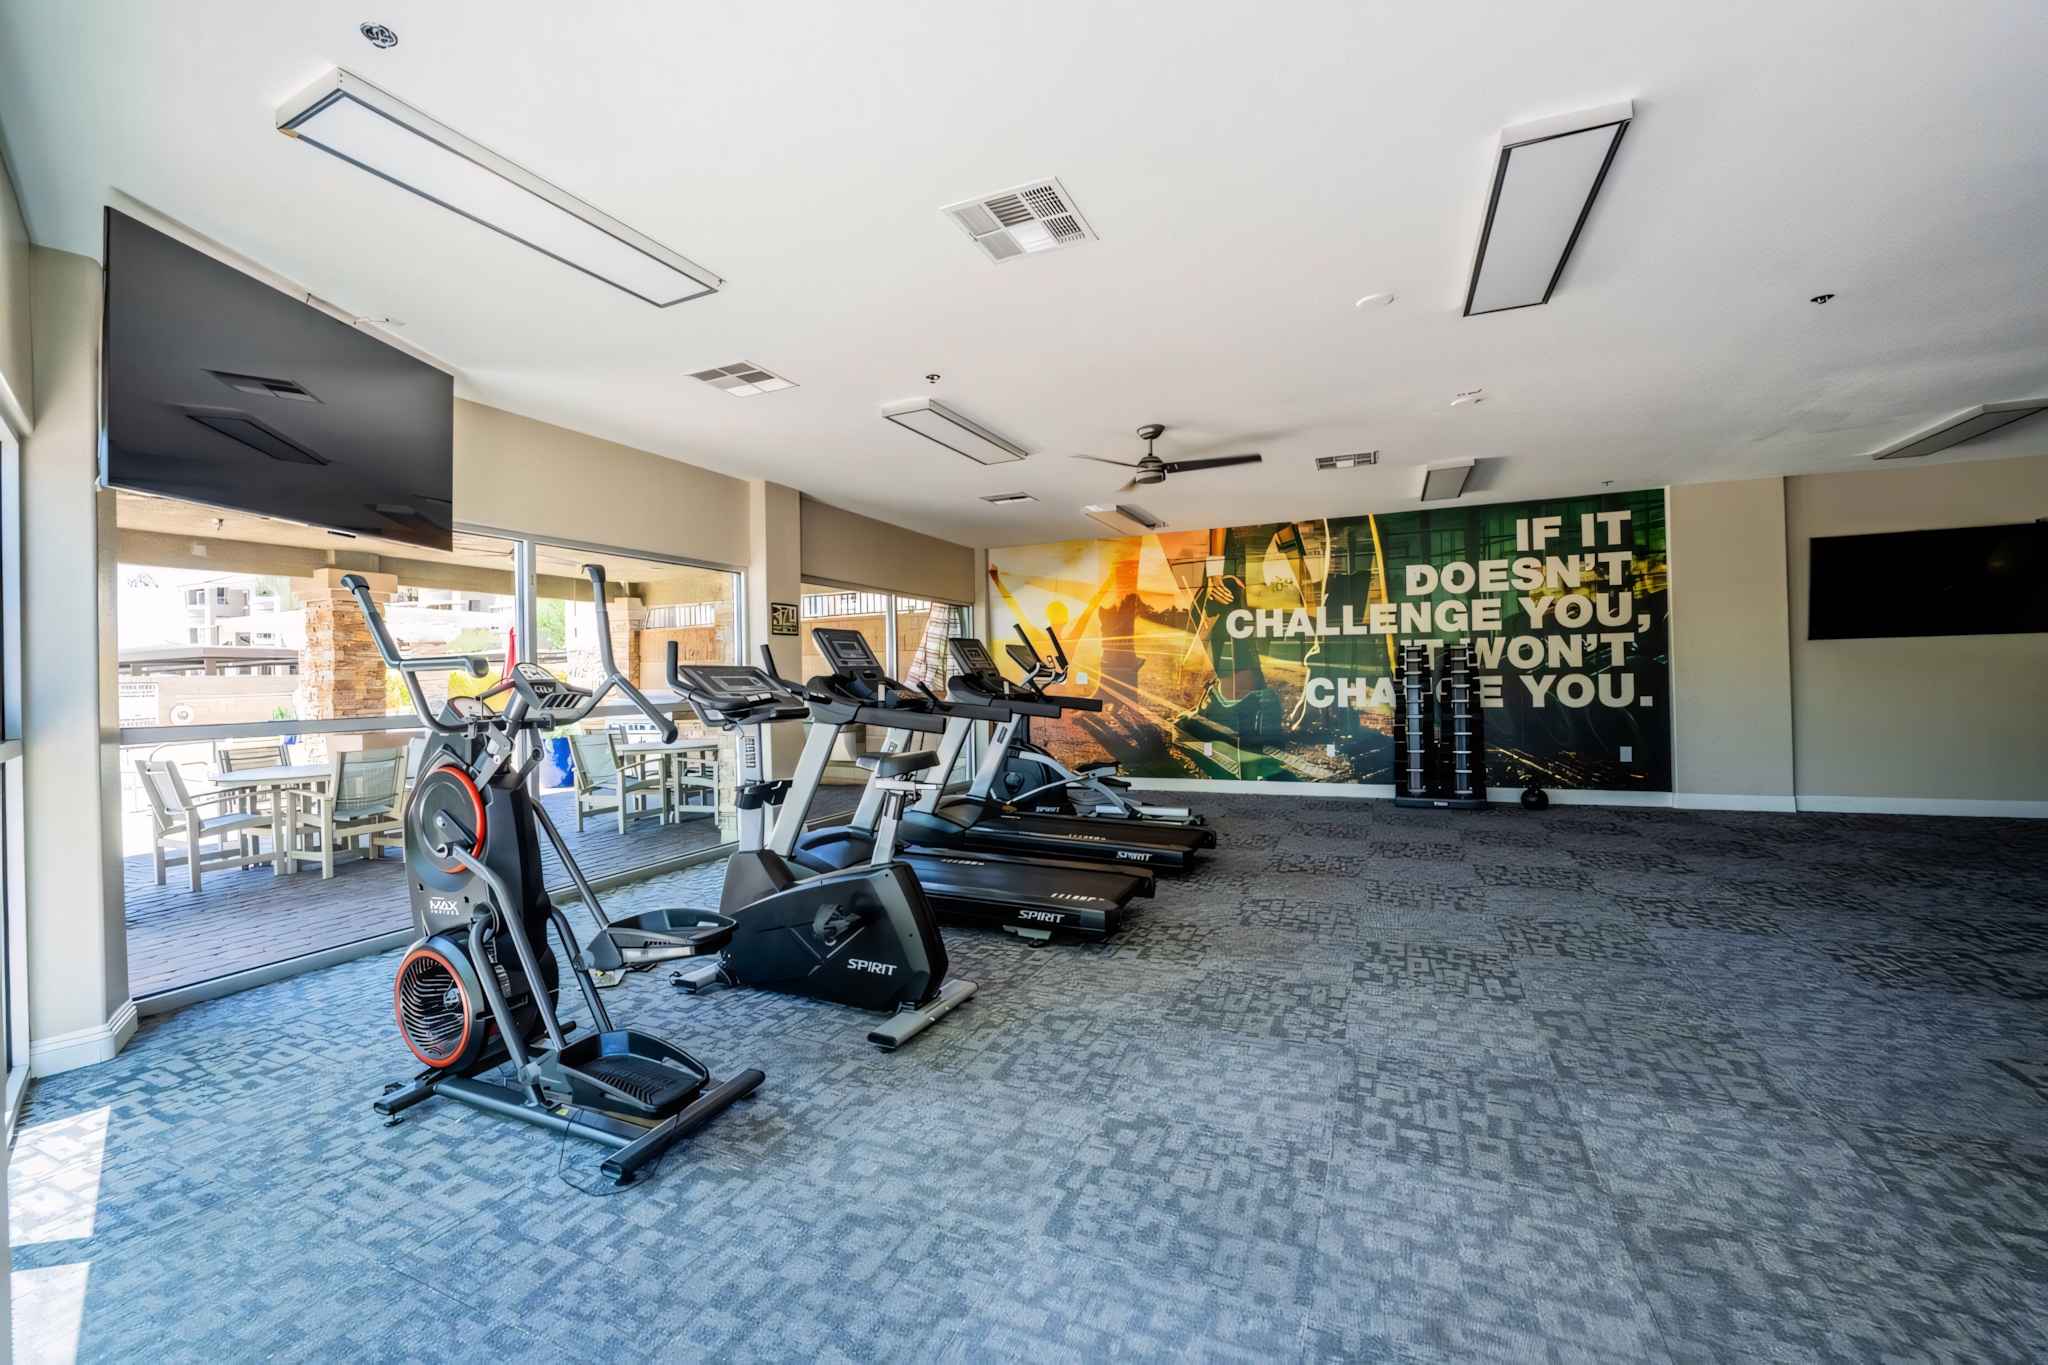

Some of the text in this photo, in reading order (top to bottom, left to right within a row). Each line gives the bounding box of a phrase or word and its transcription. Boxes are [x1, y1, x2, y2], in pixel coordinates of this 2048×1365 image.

[1516, 510, 1631, 551] IF IT
[1405, 551, 1633, 596] DOESN'T
[1226, 591, 1651, 639] CHALLENGE YOU,
[1400, 639, 1444, 671] T
[1306, 673, 1654, 709] CHAE YOU.
[429, 899, 458, 911] MAX
[1018, 909, 1065, 924] SPIRIT
[847, 958, 898, 976] SPIRIT
